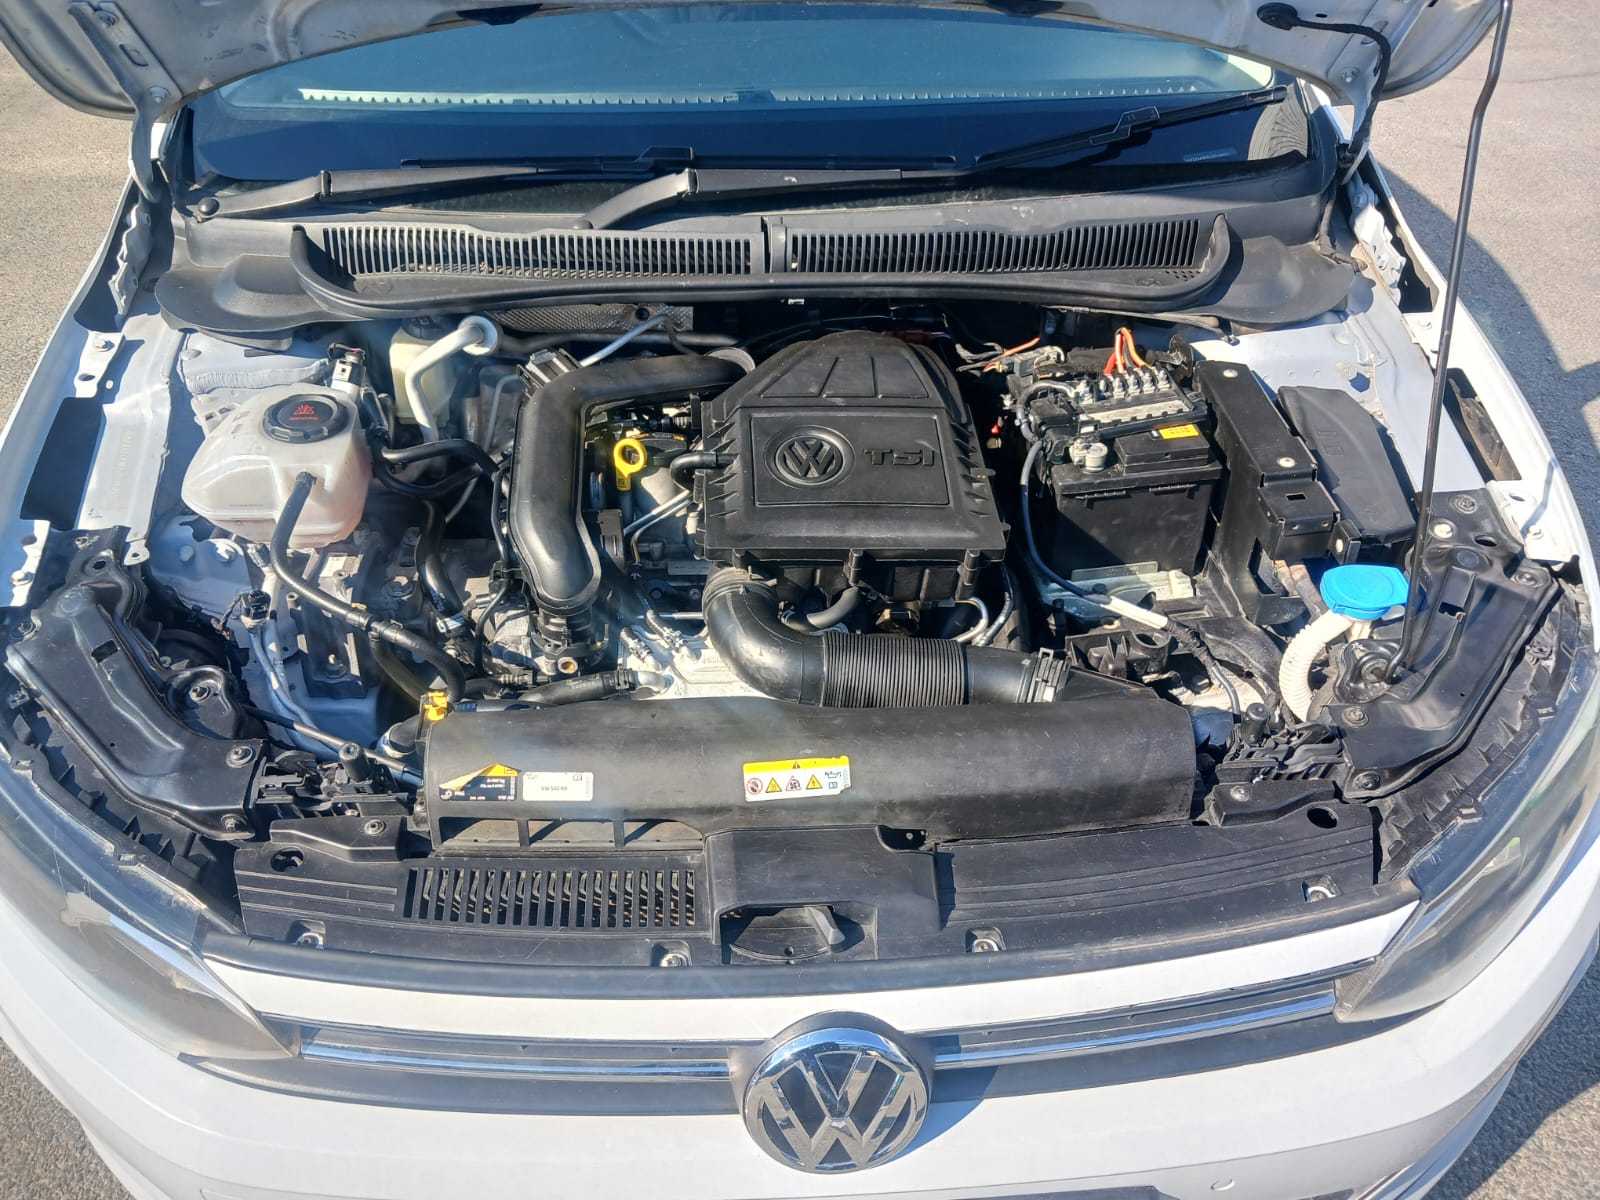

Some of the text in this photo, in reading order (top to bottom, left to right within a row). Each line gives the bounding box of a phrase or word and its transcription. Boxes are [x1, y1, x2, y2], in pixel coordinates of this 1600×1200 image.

[778, 437, 843, 482] VW
[864, 448, 935, 467] TSI
[752, 1040, 920, 1170] VW
